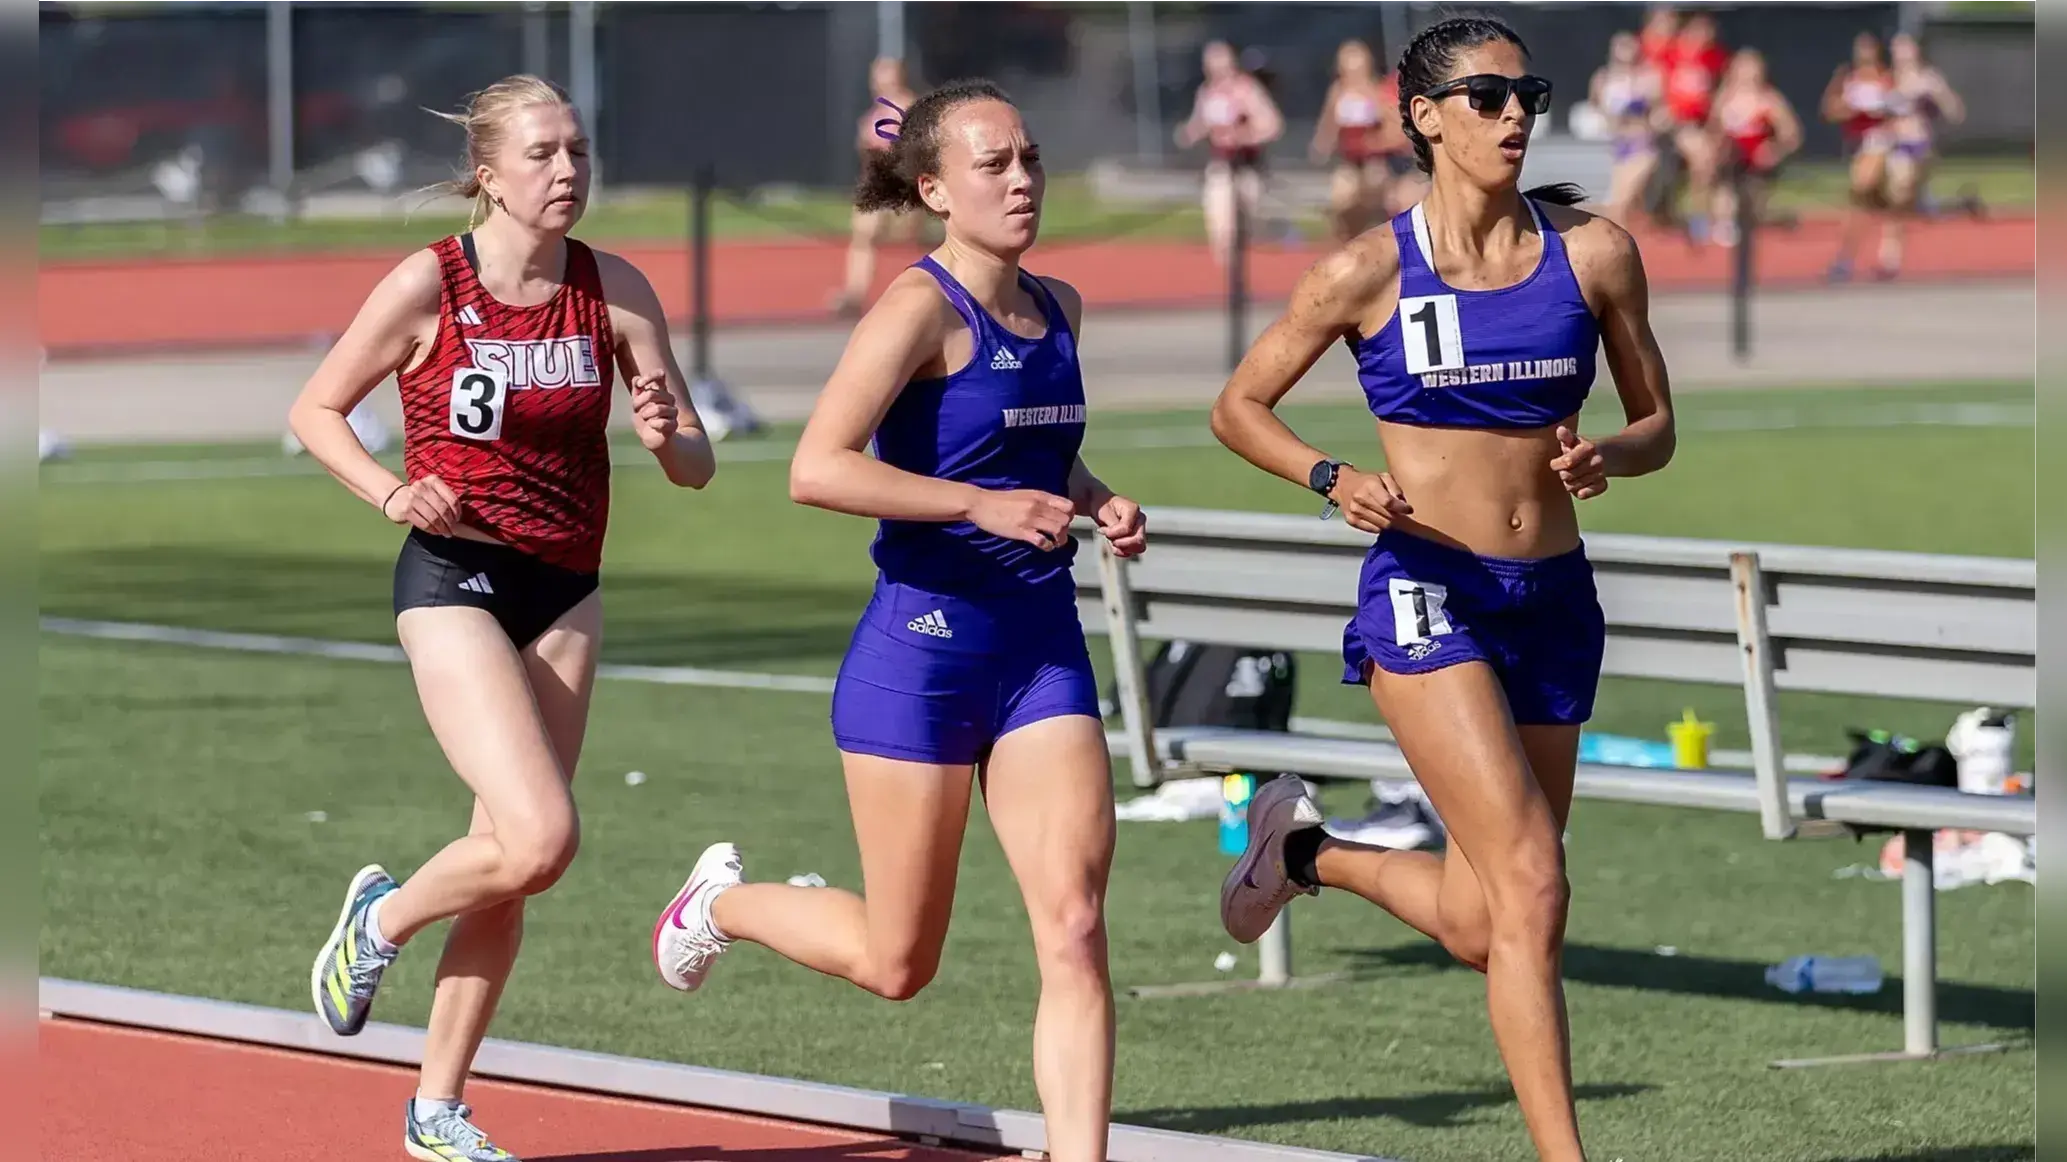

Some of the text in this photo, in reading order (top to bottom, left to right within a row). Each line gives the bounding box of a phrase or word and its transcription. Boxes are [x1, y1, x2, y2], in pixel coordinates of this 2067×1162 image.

[1410, 301, 1442, 366] 1
[465, 336, 600, 389] SIUE
[990, 360, 1023, 370] adidas
[1420, 363, 1504, 388] WESTERN
[456, 373, 496, 435] 3
[1002, 406, 1058, 428] WESTERN
[907, 621, 953, 639] adidas
[1398, 587, 1431, 638] 1
